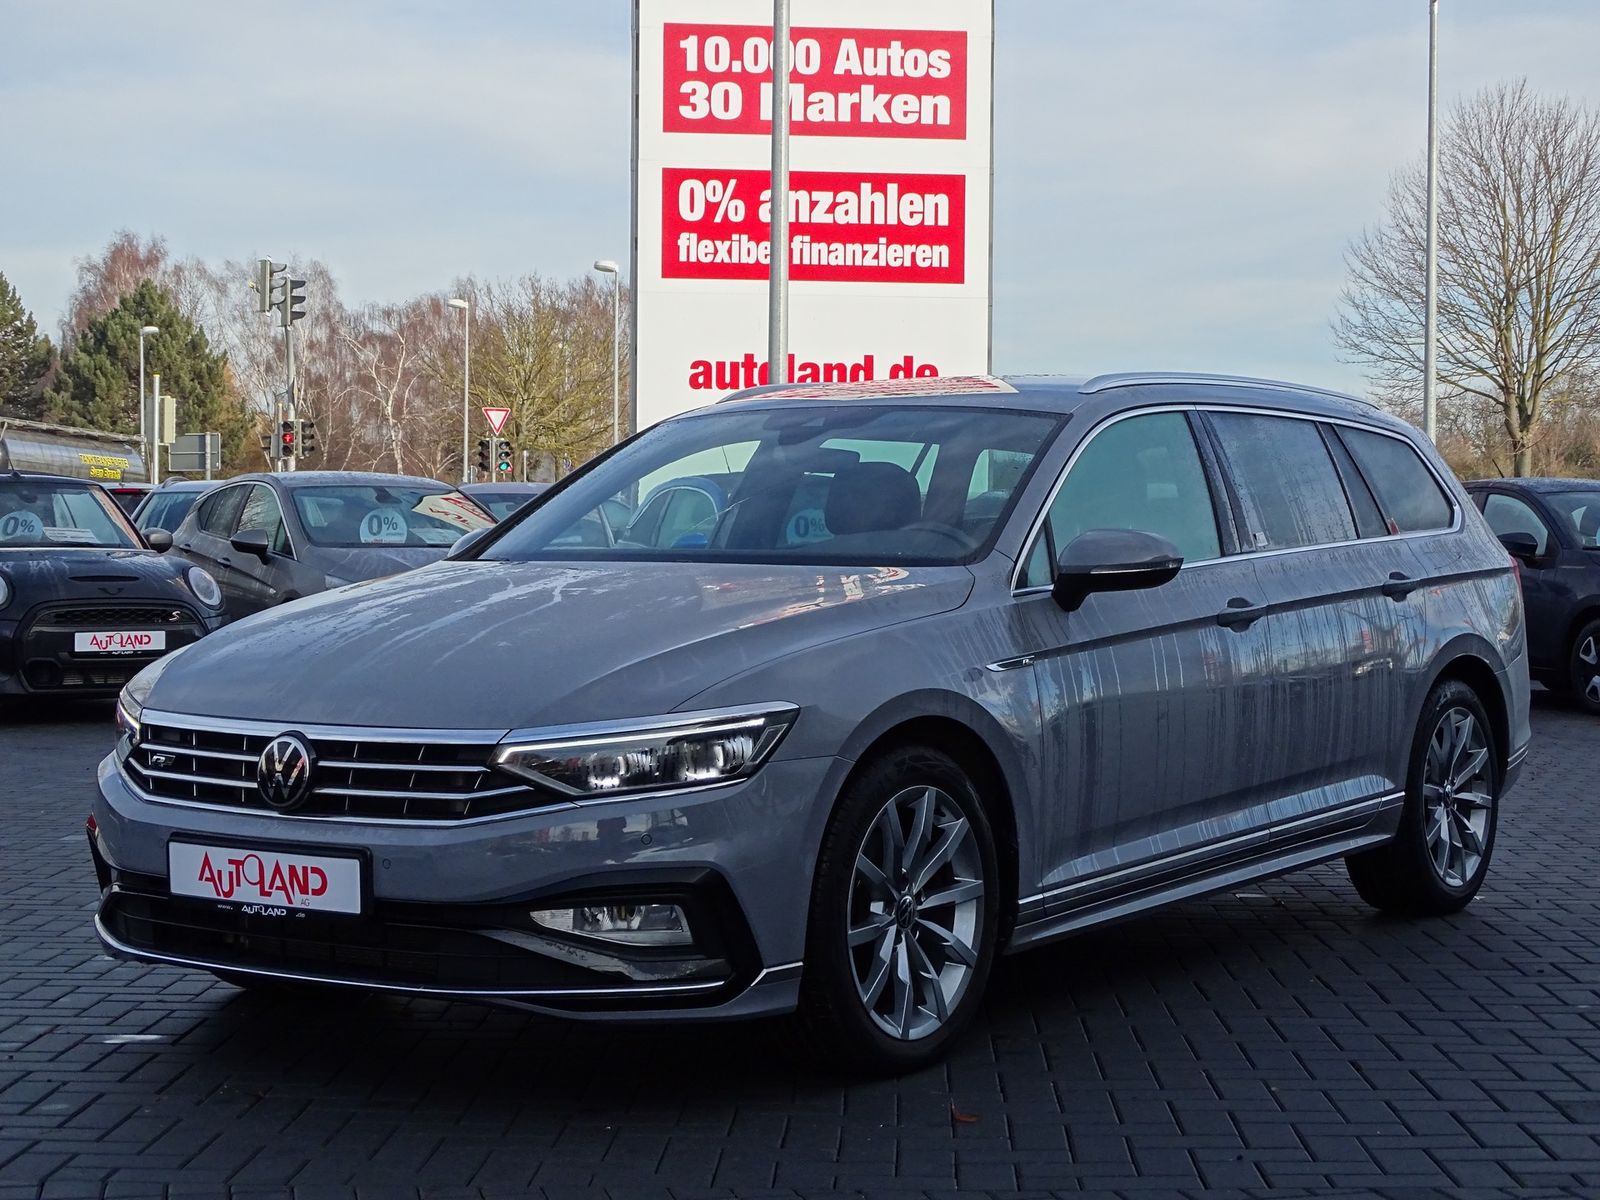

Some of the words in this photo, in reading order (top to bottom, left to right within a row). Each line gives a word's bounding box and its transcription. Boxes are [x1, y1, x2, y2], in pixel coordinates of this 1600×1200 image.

[834, 38, 951, 78] Autos
[678, 80, 742, 120] 30
[760, 83, 951, 126] Marken
[678, 179, 745, 223] 0%
[758, 183, 949, 226] anzahlen
[677, 232, 771, 264] flexibe
[791, 236, 949, 268] finanzieren
[2, 516, 35, 536] 0%
[367, 514, 398, 536] 0%
[169, 610, 181, 621] S
[300, 898, 310, 907] AG
